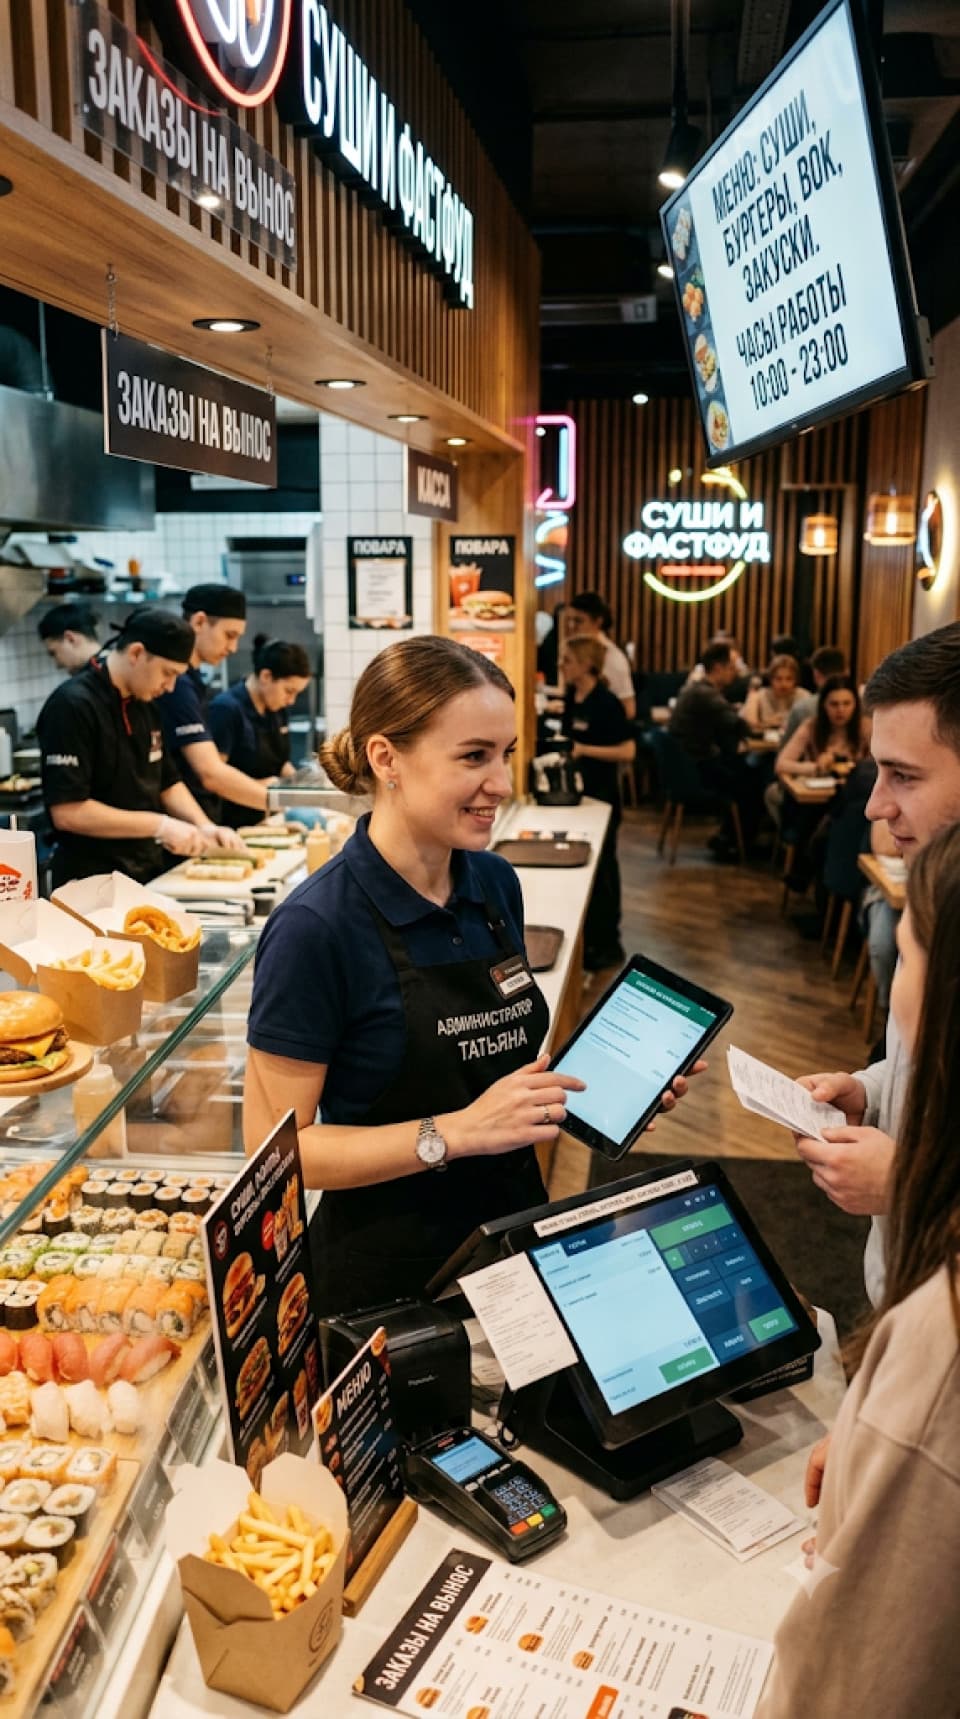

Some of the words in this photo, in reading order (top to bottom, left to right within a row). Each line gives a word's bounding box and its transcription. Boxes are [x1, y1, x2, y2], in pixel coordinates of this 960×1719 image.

[89, 29, 197, 176] ЗАКАЗЫ
[203, 121, 230, 200] НА
[234, 147, 295, 248] ВЫНОС
[302, 0, 378, 191] СУШИ
[381, 92, 396, 210] И
[399, 122, 474, 309] ФАСТФУД
[712, 150, 760, 225] МЕНЮ:
[760, 88, 816, 175] СУШИ,
[723, 171, 798, 267] БУРГЕРЫ,
[797, 129, 843, 203] ВОК,
[742, 214, 820, 303] ЗАКУСКИ.
[736, 312, 778, 367] ЧАСЫ
[777, 263, 847, 344] РАБОТЫ
[750, 358, 790, 411] 10:00
[799, 323, 849, 386] 23:00
[118, 370, 195, 443] ЗАКАЗЫ
[198, 397, 221, 449] НА
[222, 406, 272, 463] ВЫНОС
[622, 531, 771, 563] ФАСТФУД
[641, 501, 735, 529] СУШИ
[739, 501, 764, 529] И
[457, 1026, 528, 1061] ТАТЬЯНА
[336, 1361, 372, 1419] МЕНЮ
[415, 1612, 445, 1633] НА
[429, 1564, 475, 1612] ВЫНОС
